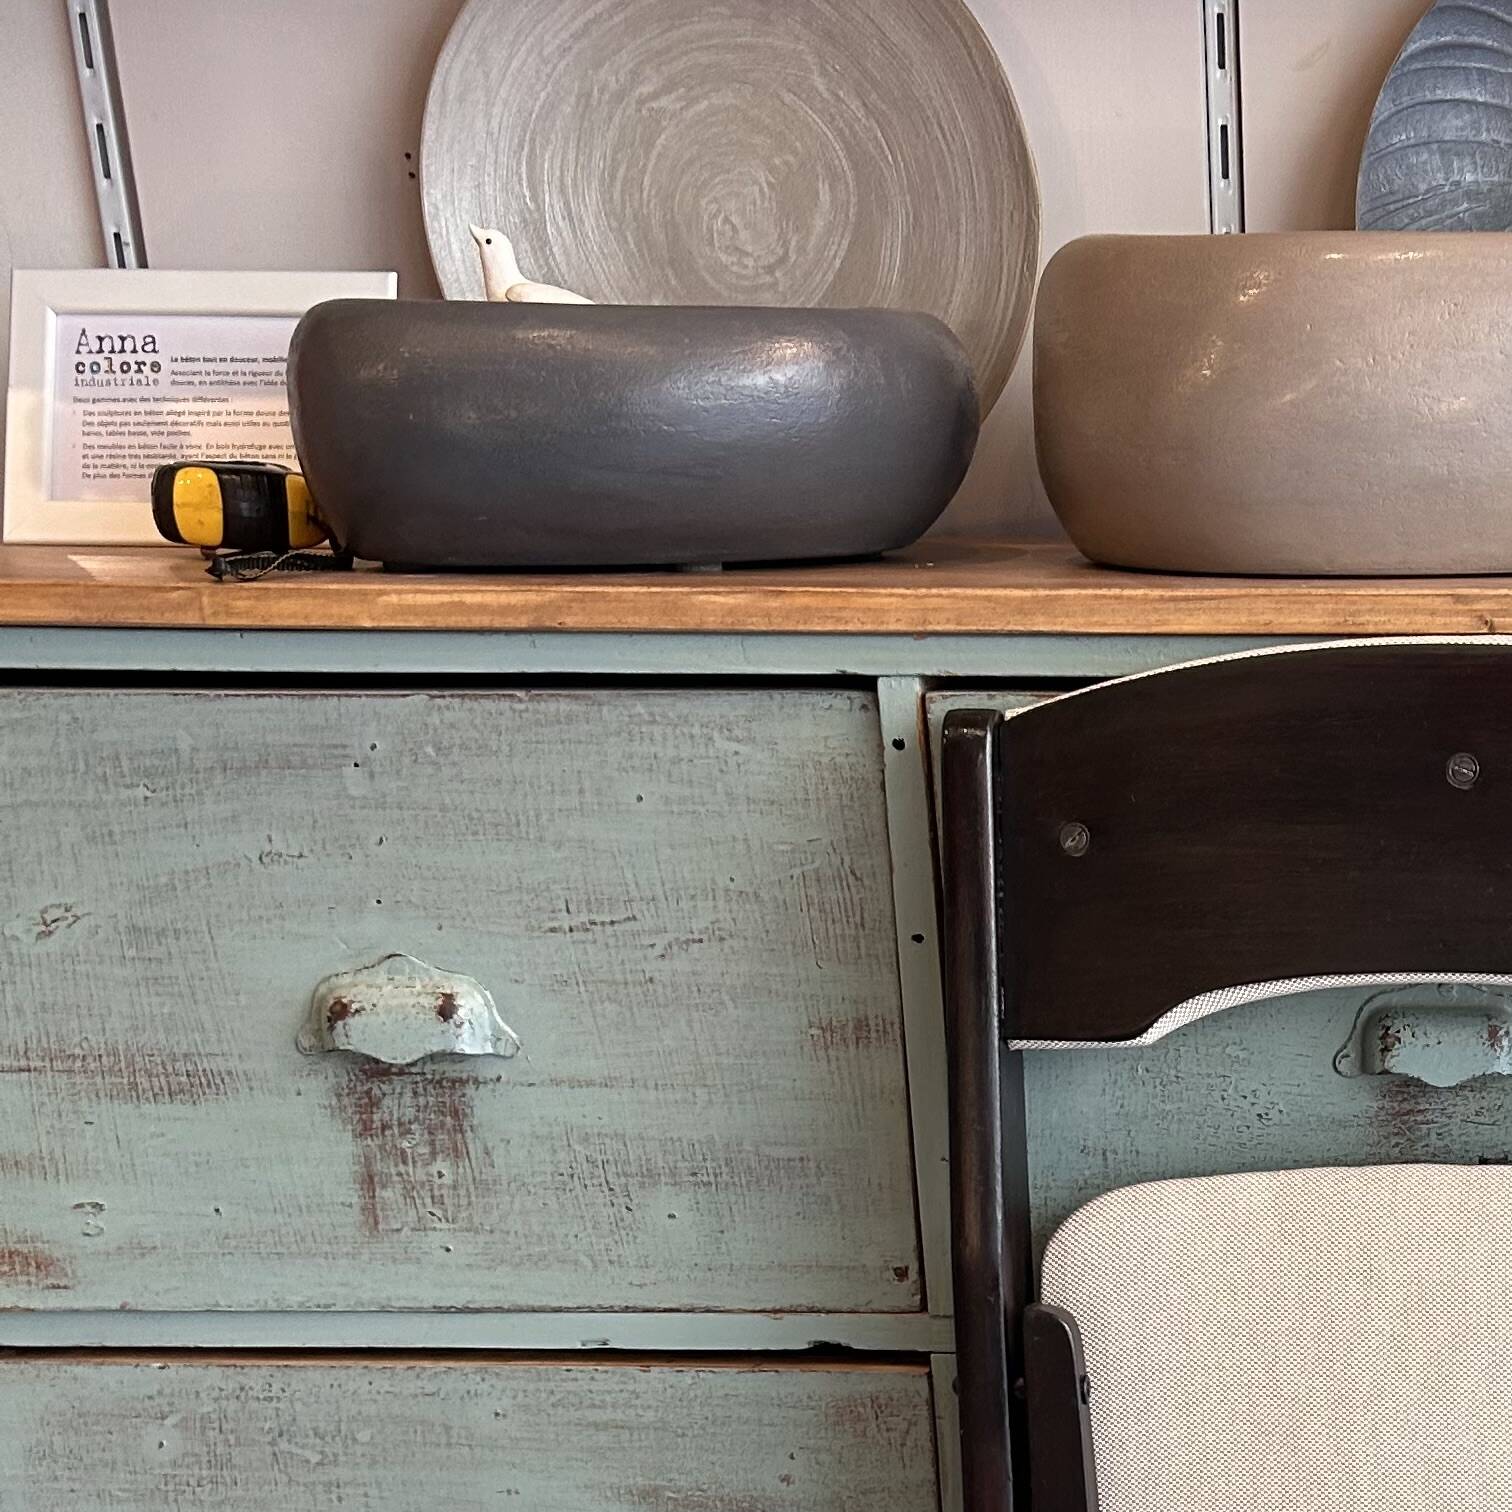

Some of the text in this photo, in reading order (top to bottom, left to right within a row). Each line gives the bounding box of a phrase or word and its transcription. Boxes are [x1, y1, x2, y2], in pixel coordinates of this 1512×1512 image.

[75, 327, 159, 354] Anna
[75, 356, 162, 374] colore
[74, 376, 160, 387] industriale
